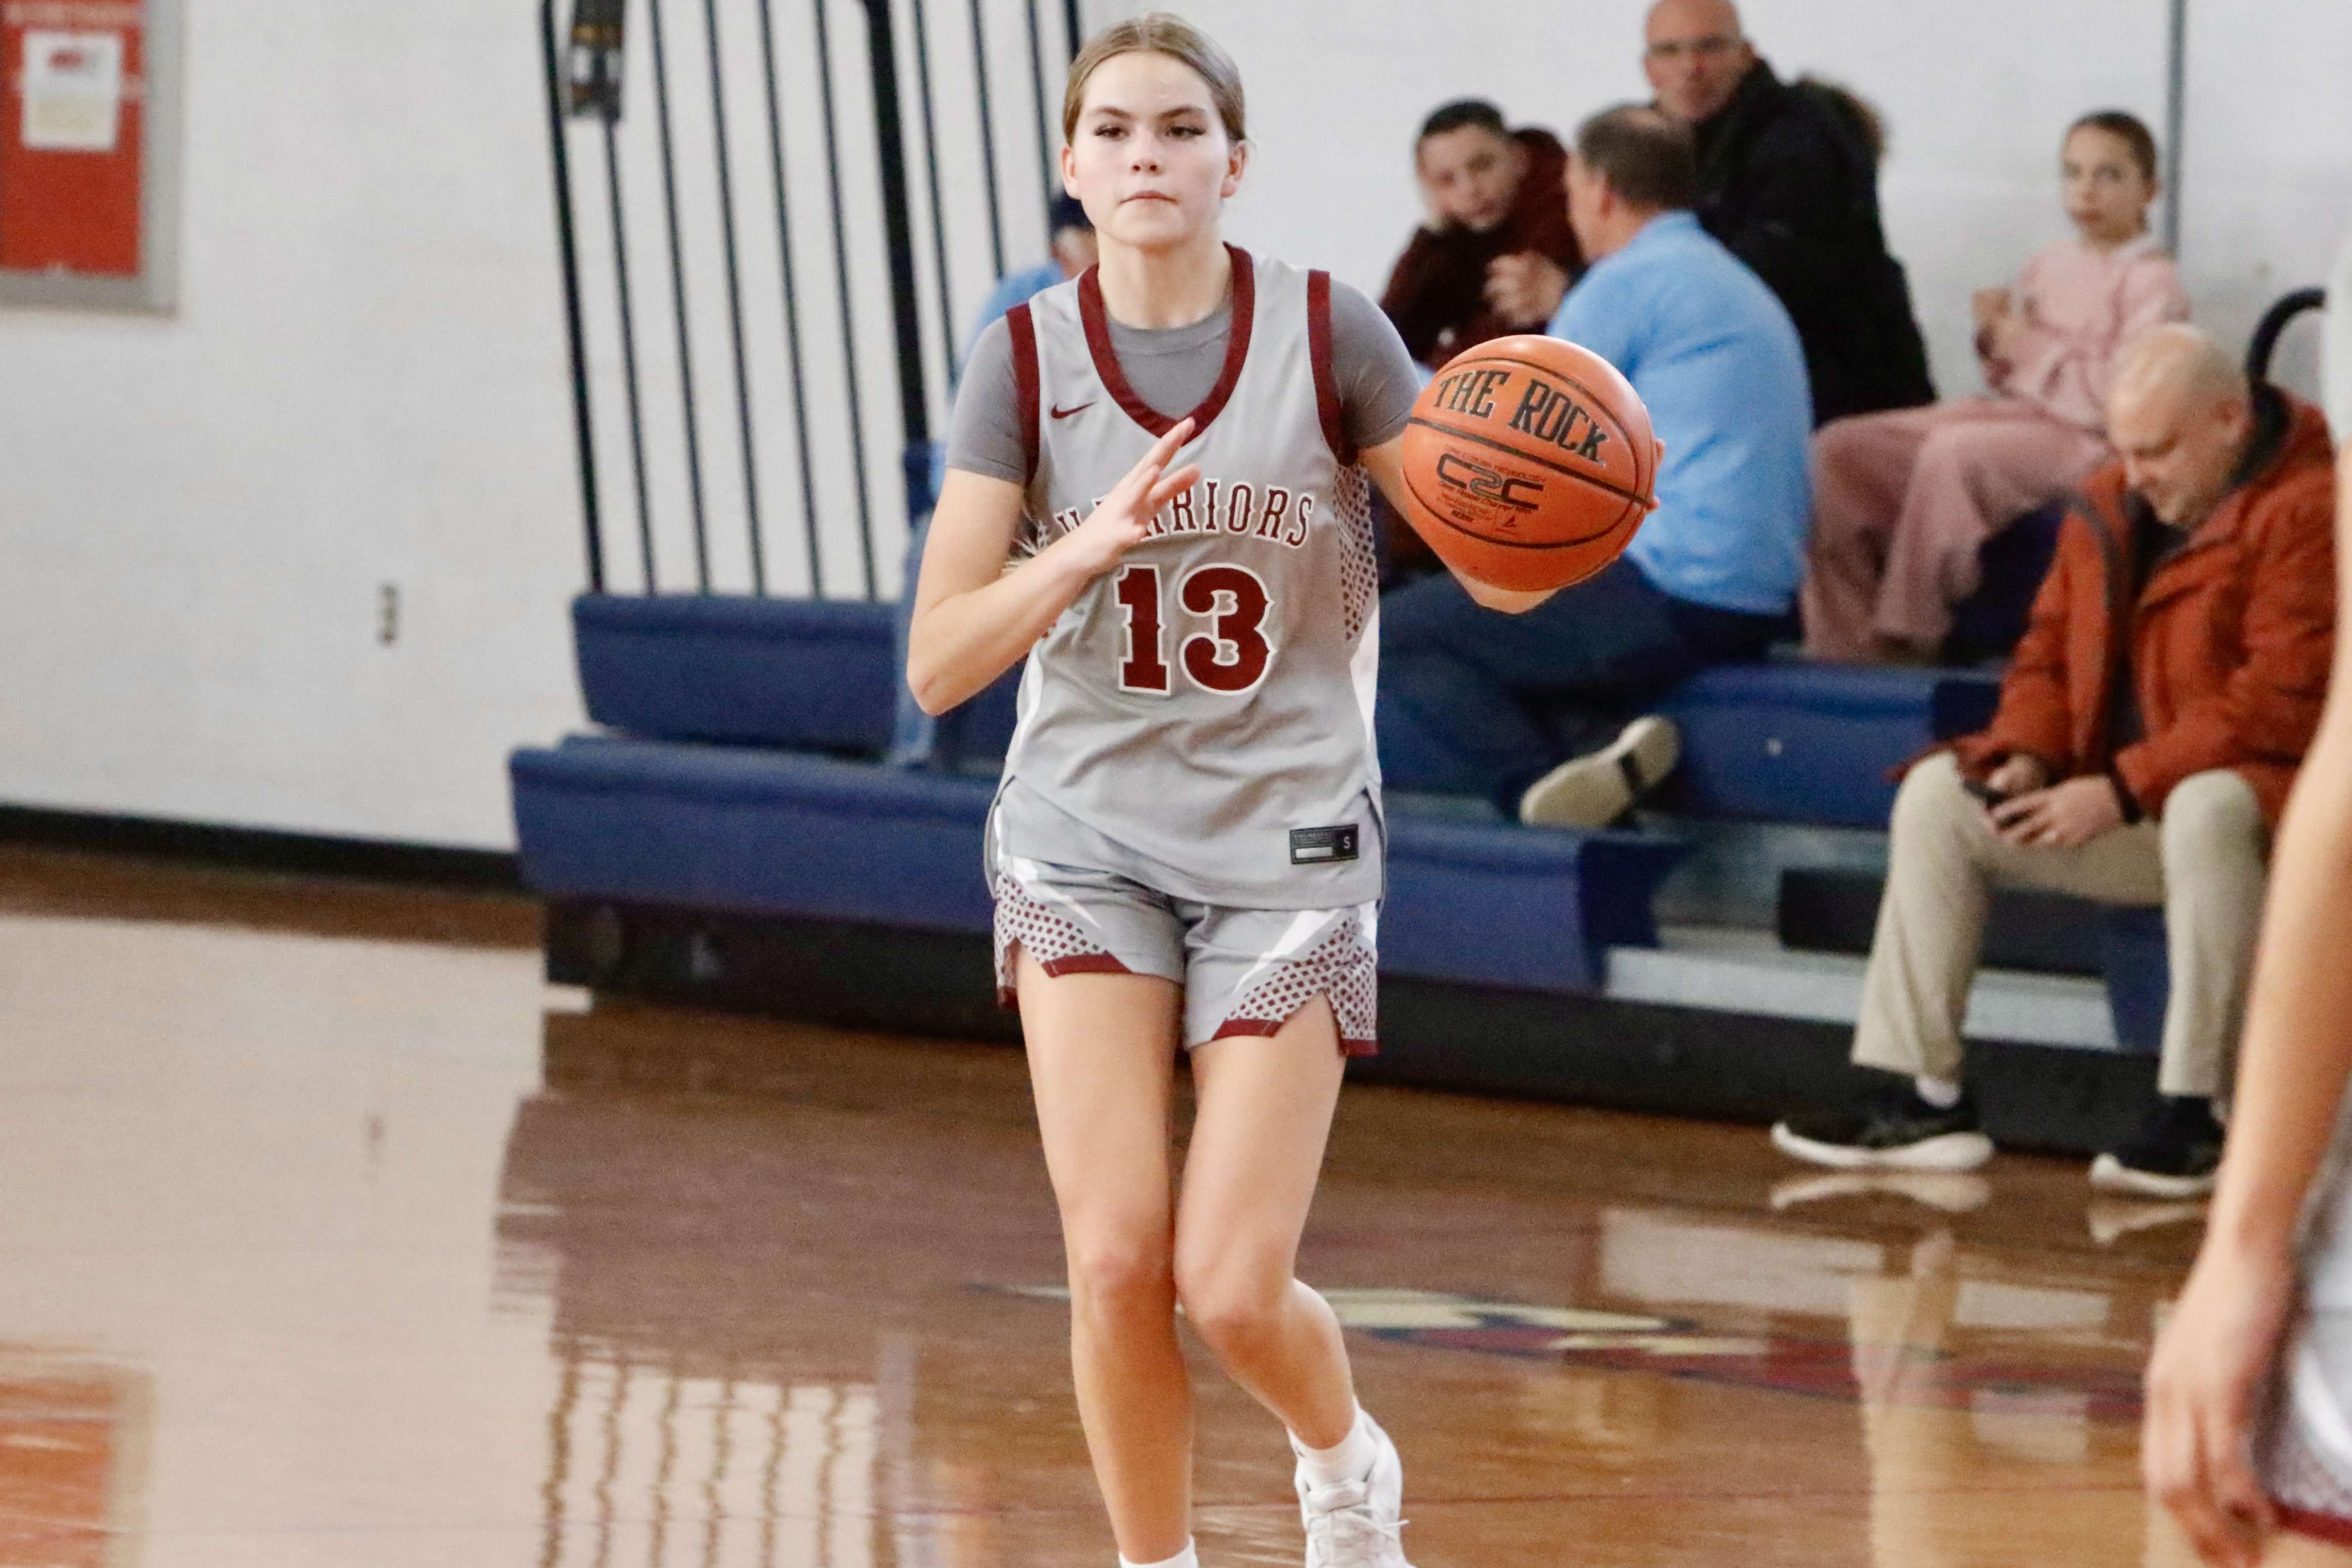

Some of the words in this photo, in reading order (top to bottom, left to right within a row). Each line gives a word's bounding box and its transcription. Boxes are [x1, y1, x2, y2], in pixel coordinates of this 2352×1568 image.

[1434, 369, 1511, 418] THE
[1507, 378, 1609, 463] ROCK
[1053, 478, 1313, 549] RIORS
[1437, 453, 1544, 511] C2C
[1113, 563, 1277, 696] 13
[1343, 836, 1351, 849] S
